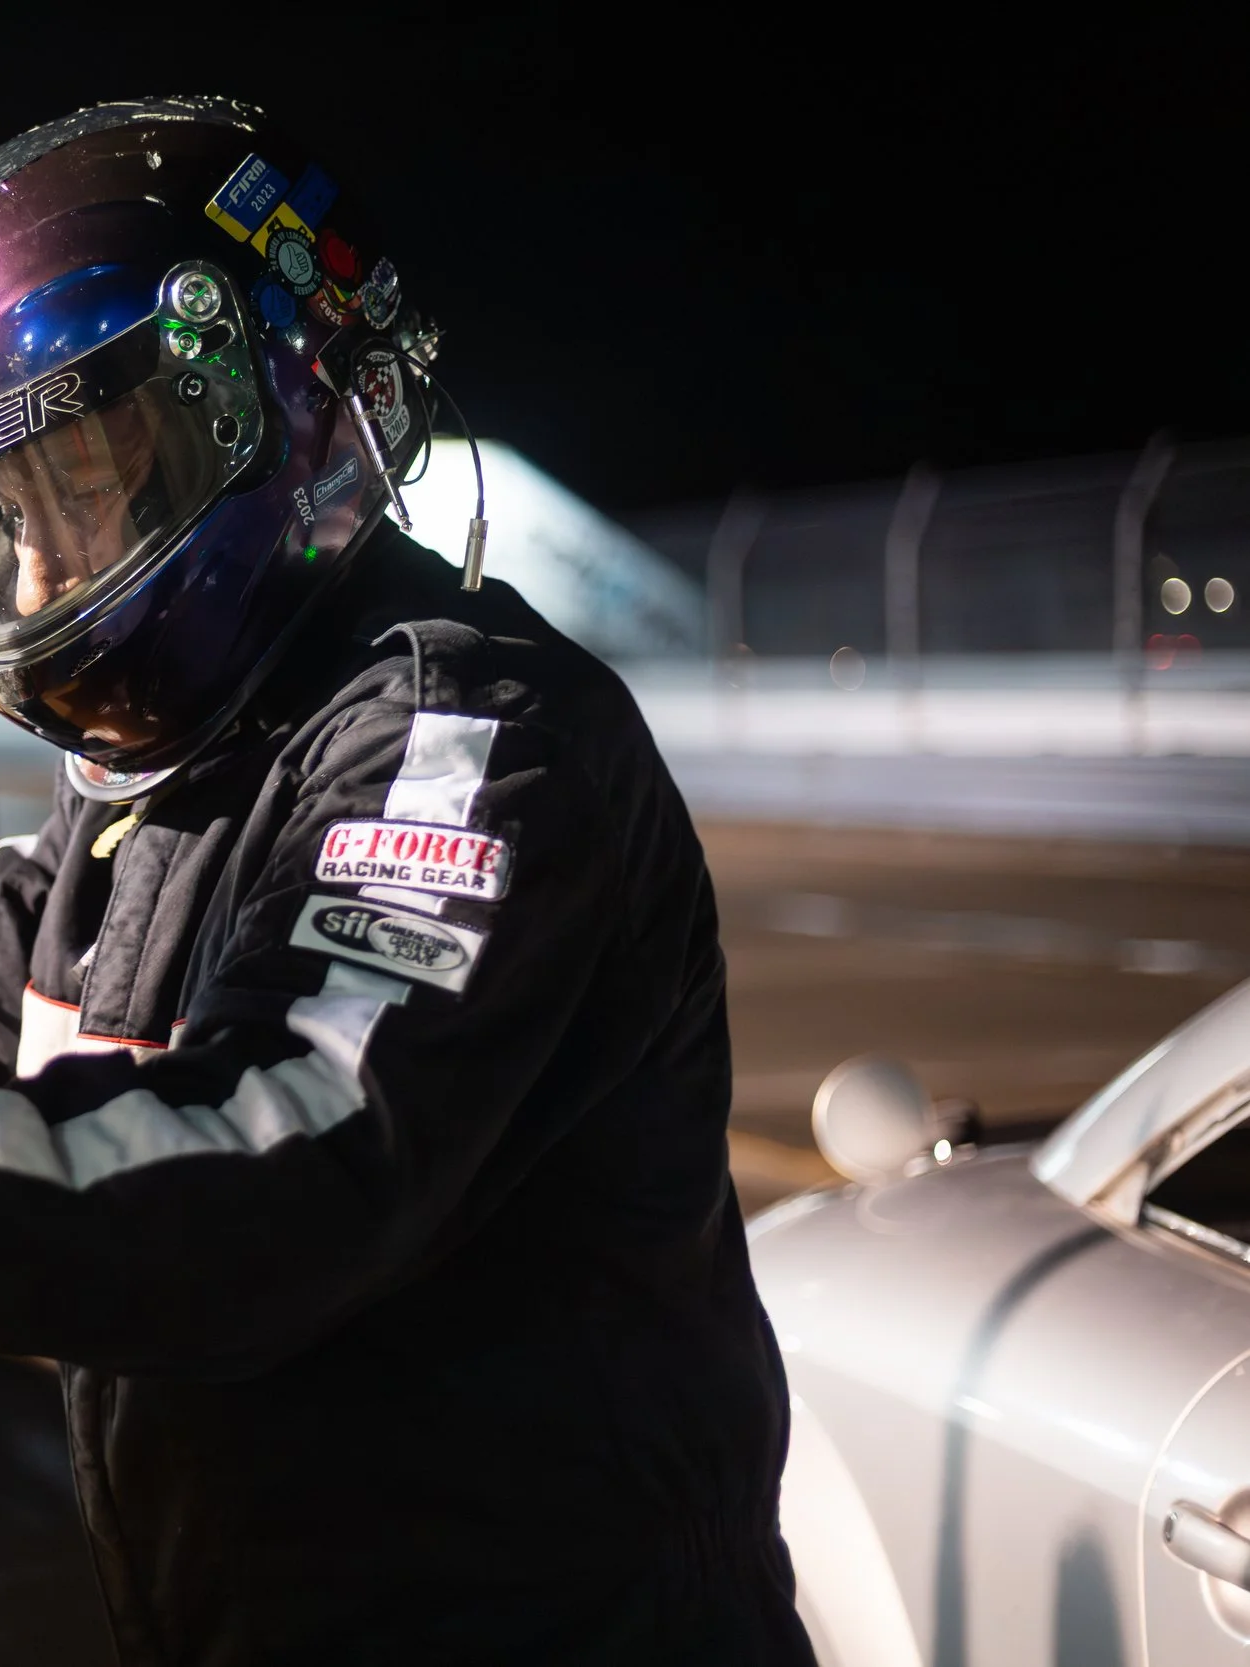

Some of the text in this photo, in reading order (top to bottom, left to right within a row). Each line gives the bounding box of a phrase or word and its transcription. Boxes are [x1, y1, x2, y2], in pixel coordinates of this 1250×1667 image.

[229, 159, 266, 204] FIRM
[251, 183, 276, 212] 2023
[319, 300, 342, 326] 2022
[293, 487, 315, 526] 2023
[324, 828, 502, 874] G-FORCE
[322, 861, 487, 891] RACING GEAR
